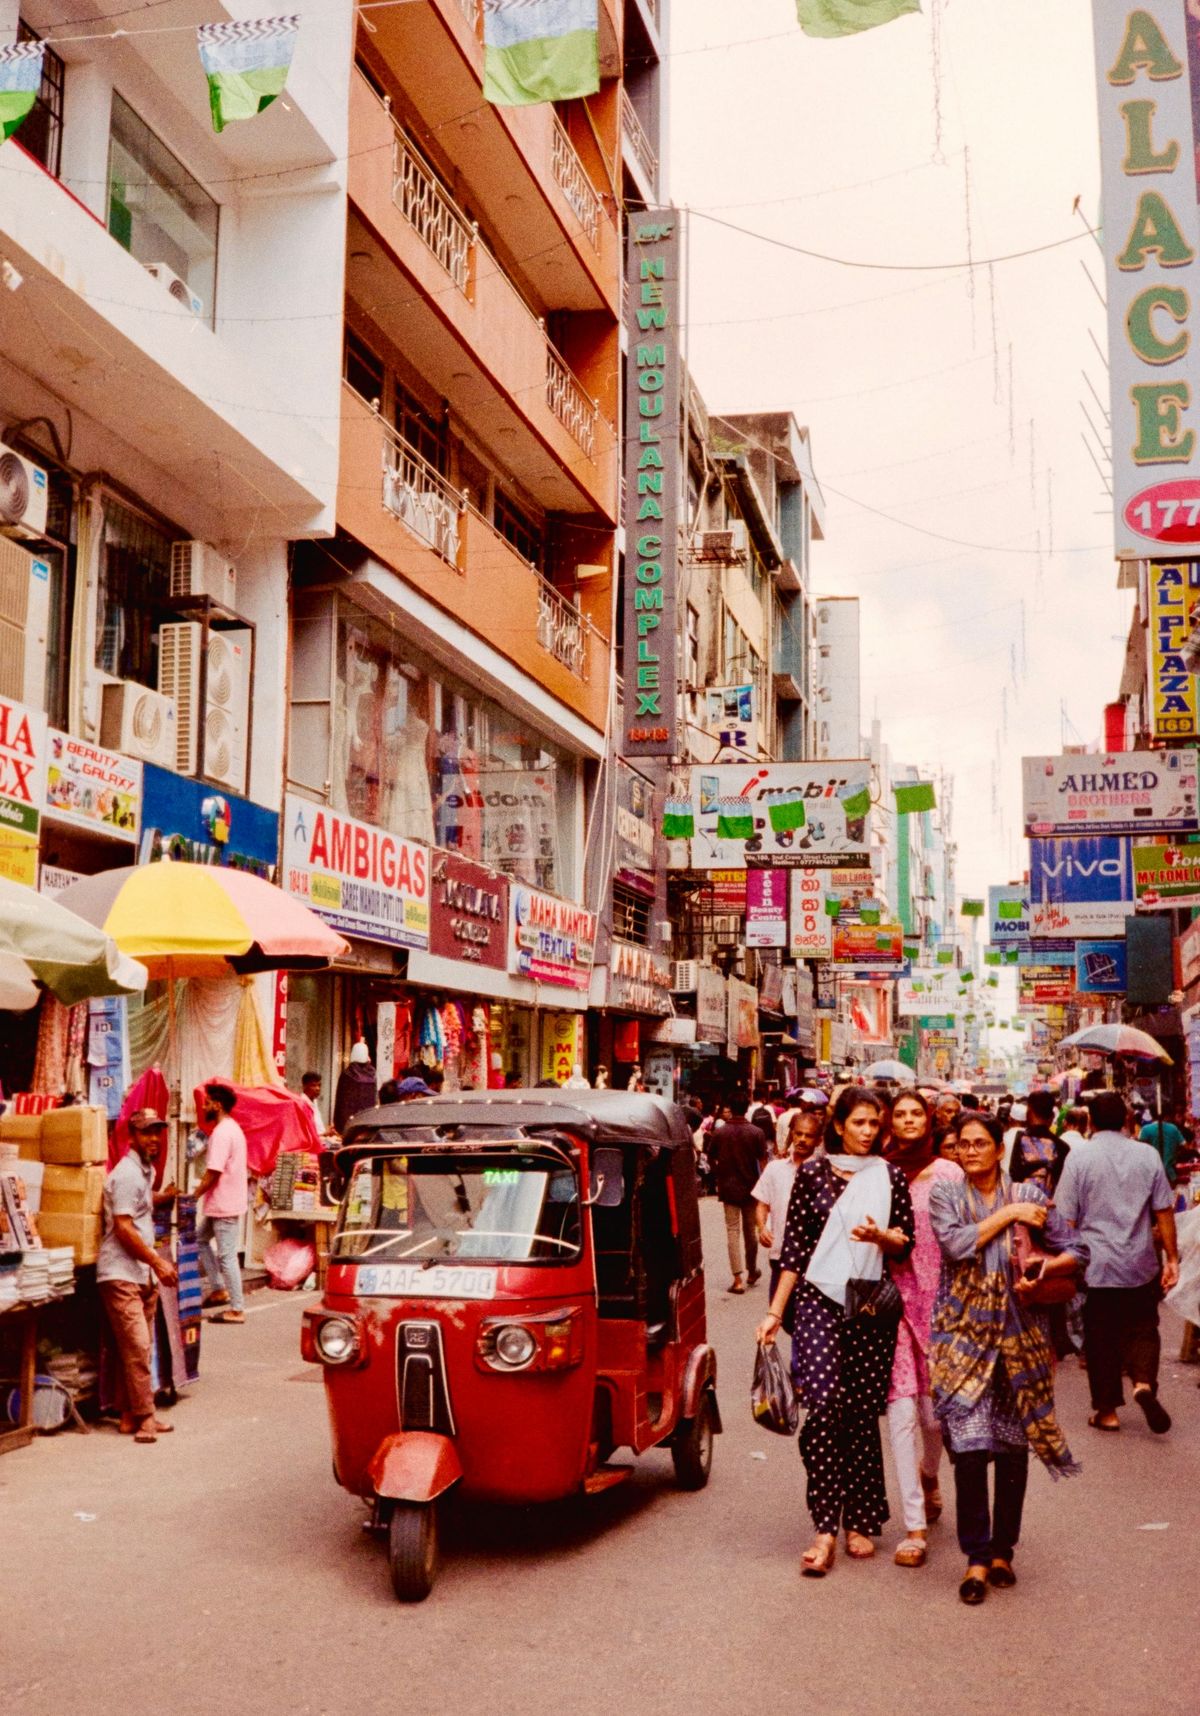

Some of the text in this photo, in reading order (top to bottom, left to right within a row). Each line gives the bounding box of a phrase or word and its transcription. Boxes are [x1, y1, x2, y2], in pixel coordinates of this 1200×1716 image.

[1107, 9, 1195, 466] ALACE
[634, 257, 668, 716] NEW MOULANA COMPLEX
[1157, 568, 1191, 713] AL PLAZA
[1159, 719, 1191, 733] 169
[67, 741, 120, 769] BEAUTY
[82, 763, 136, 792] GALAXY
[1058, 770, 1158, 793] AHMED
[1068, 791, 1152, 807] BROTHERS
[309, 811, 426, 898] AMBIGAS
[1041, 855, 1121, 878] vivo
[1137, 871, 1155, 884] MY
[1160, 869, 1189, 882] FONE
[530, 895, 556, 928] MAHA
[750, 906, 783, 914] Beauty
[539, 931, 575, 960] TEXTILE
[483, 1170, 519, 1185] TAXI
